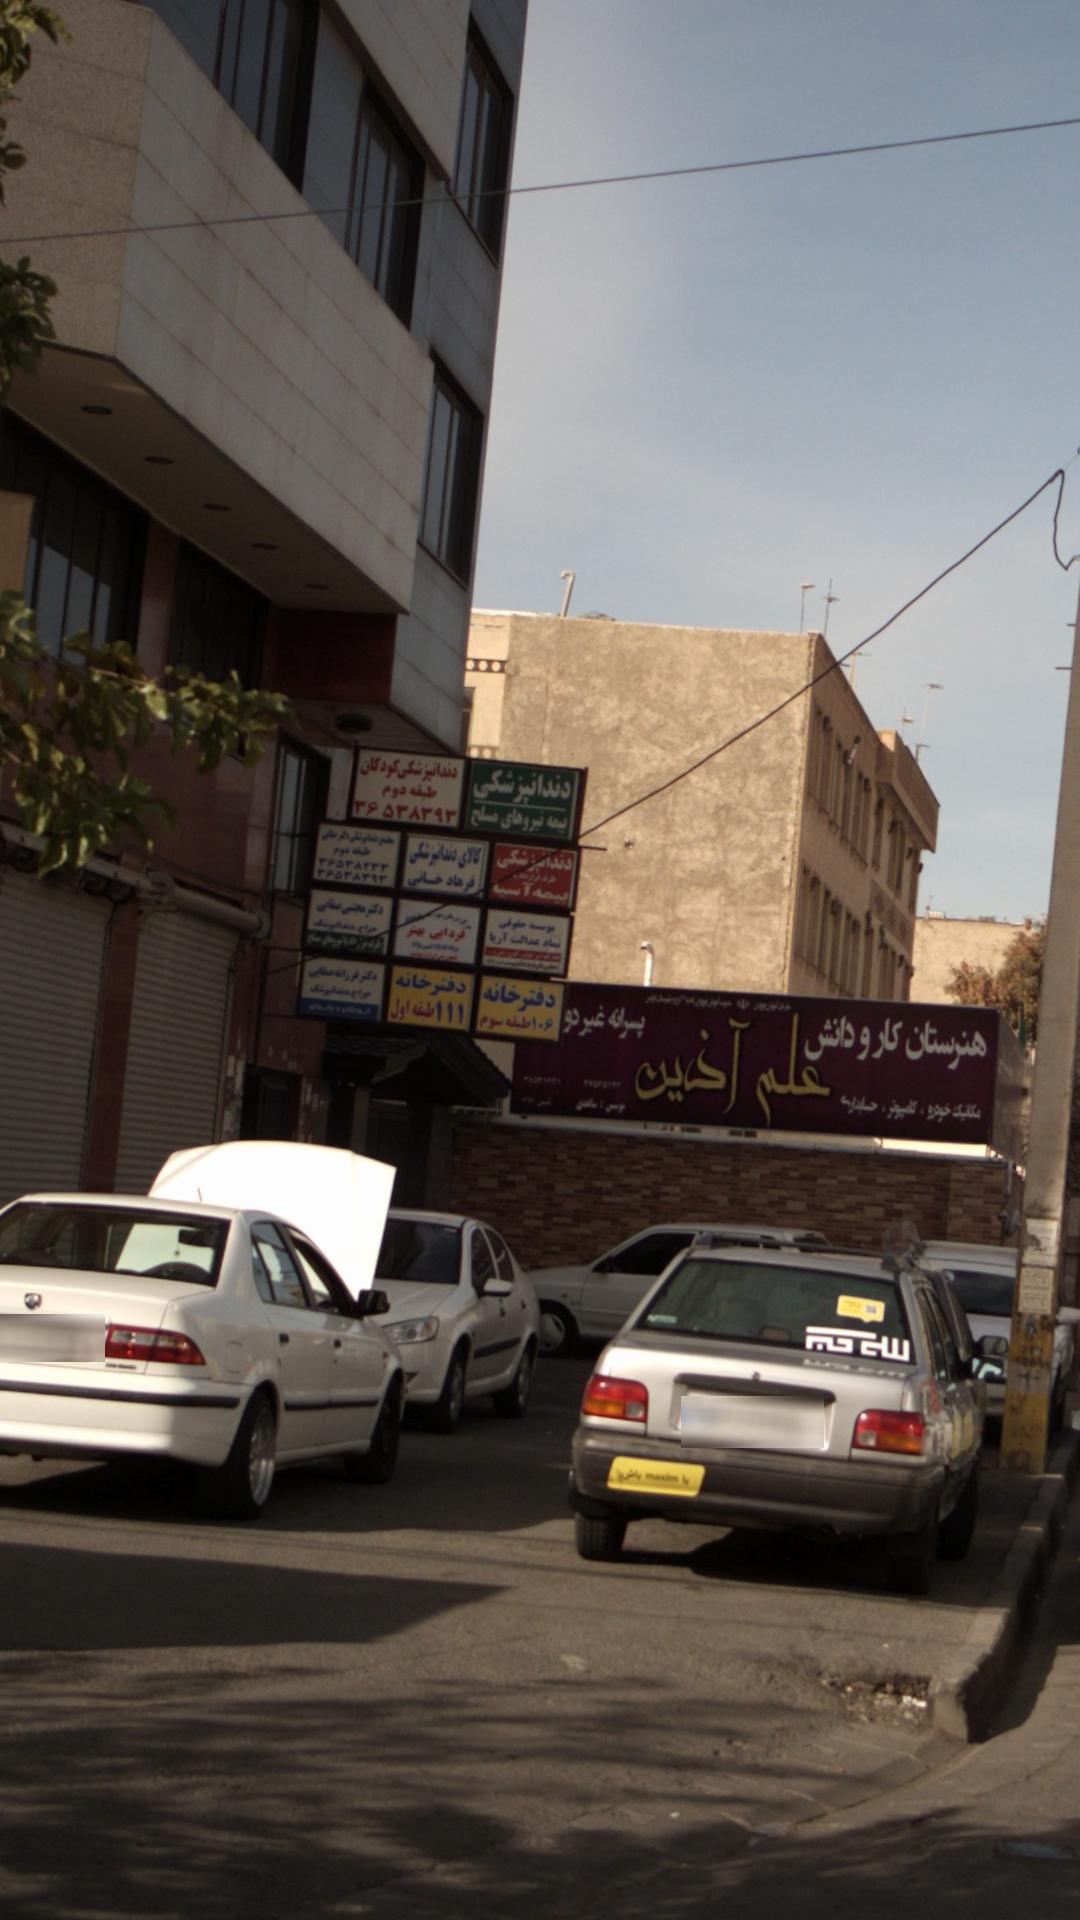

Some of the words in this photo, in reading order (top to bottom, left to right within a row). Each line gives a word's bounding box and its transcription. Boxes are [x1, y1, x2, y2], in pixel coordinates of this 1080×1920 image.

[382, 785, 406, 799] دوم
[409, 785, 437, 801] طبقه
[473, 769, 571, 804] دندانپزشکی
[470, 805, 499, 826] مسلح
[500, 809, 545, 832] نیروهای
[546, 815, 568, 834] بیمه
[391, 998, 410, 1020] اول
[412, 1001, 434, 1021] طبقه
[578, 1005, 605, 1037] غیر
[608, 1007, 646, 1039] پسرانه
[804, 1015, 855, 1061] دانش
[856, 1025, 870, 1061] و
[872, 1017, 902, 1059] کار
[905, 1020, 987, 1070] هنرستان
[755, 1011, 831, 1128] علم
